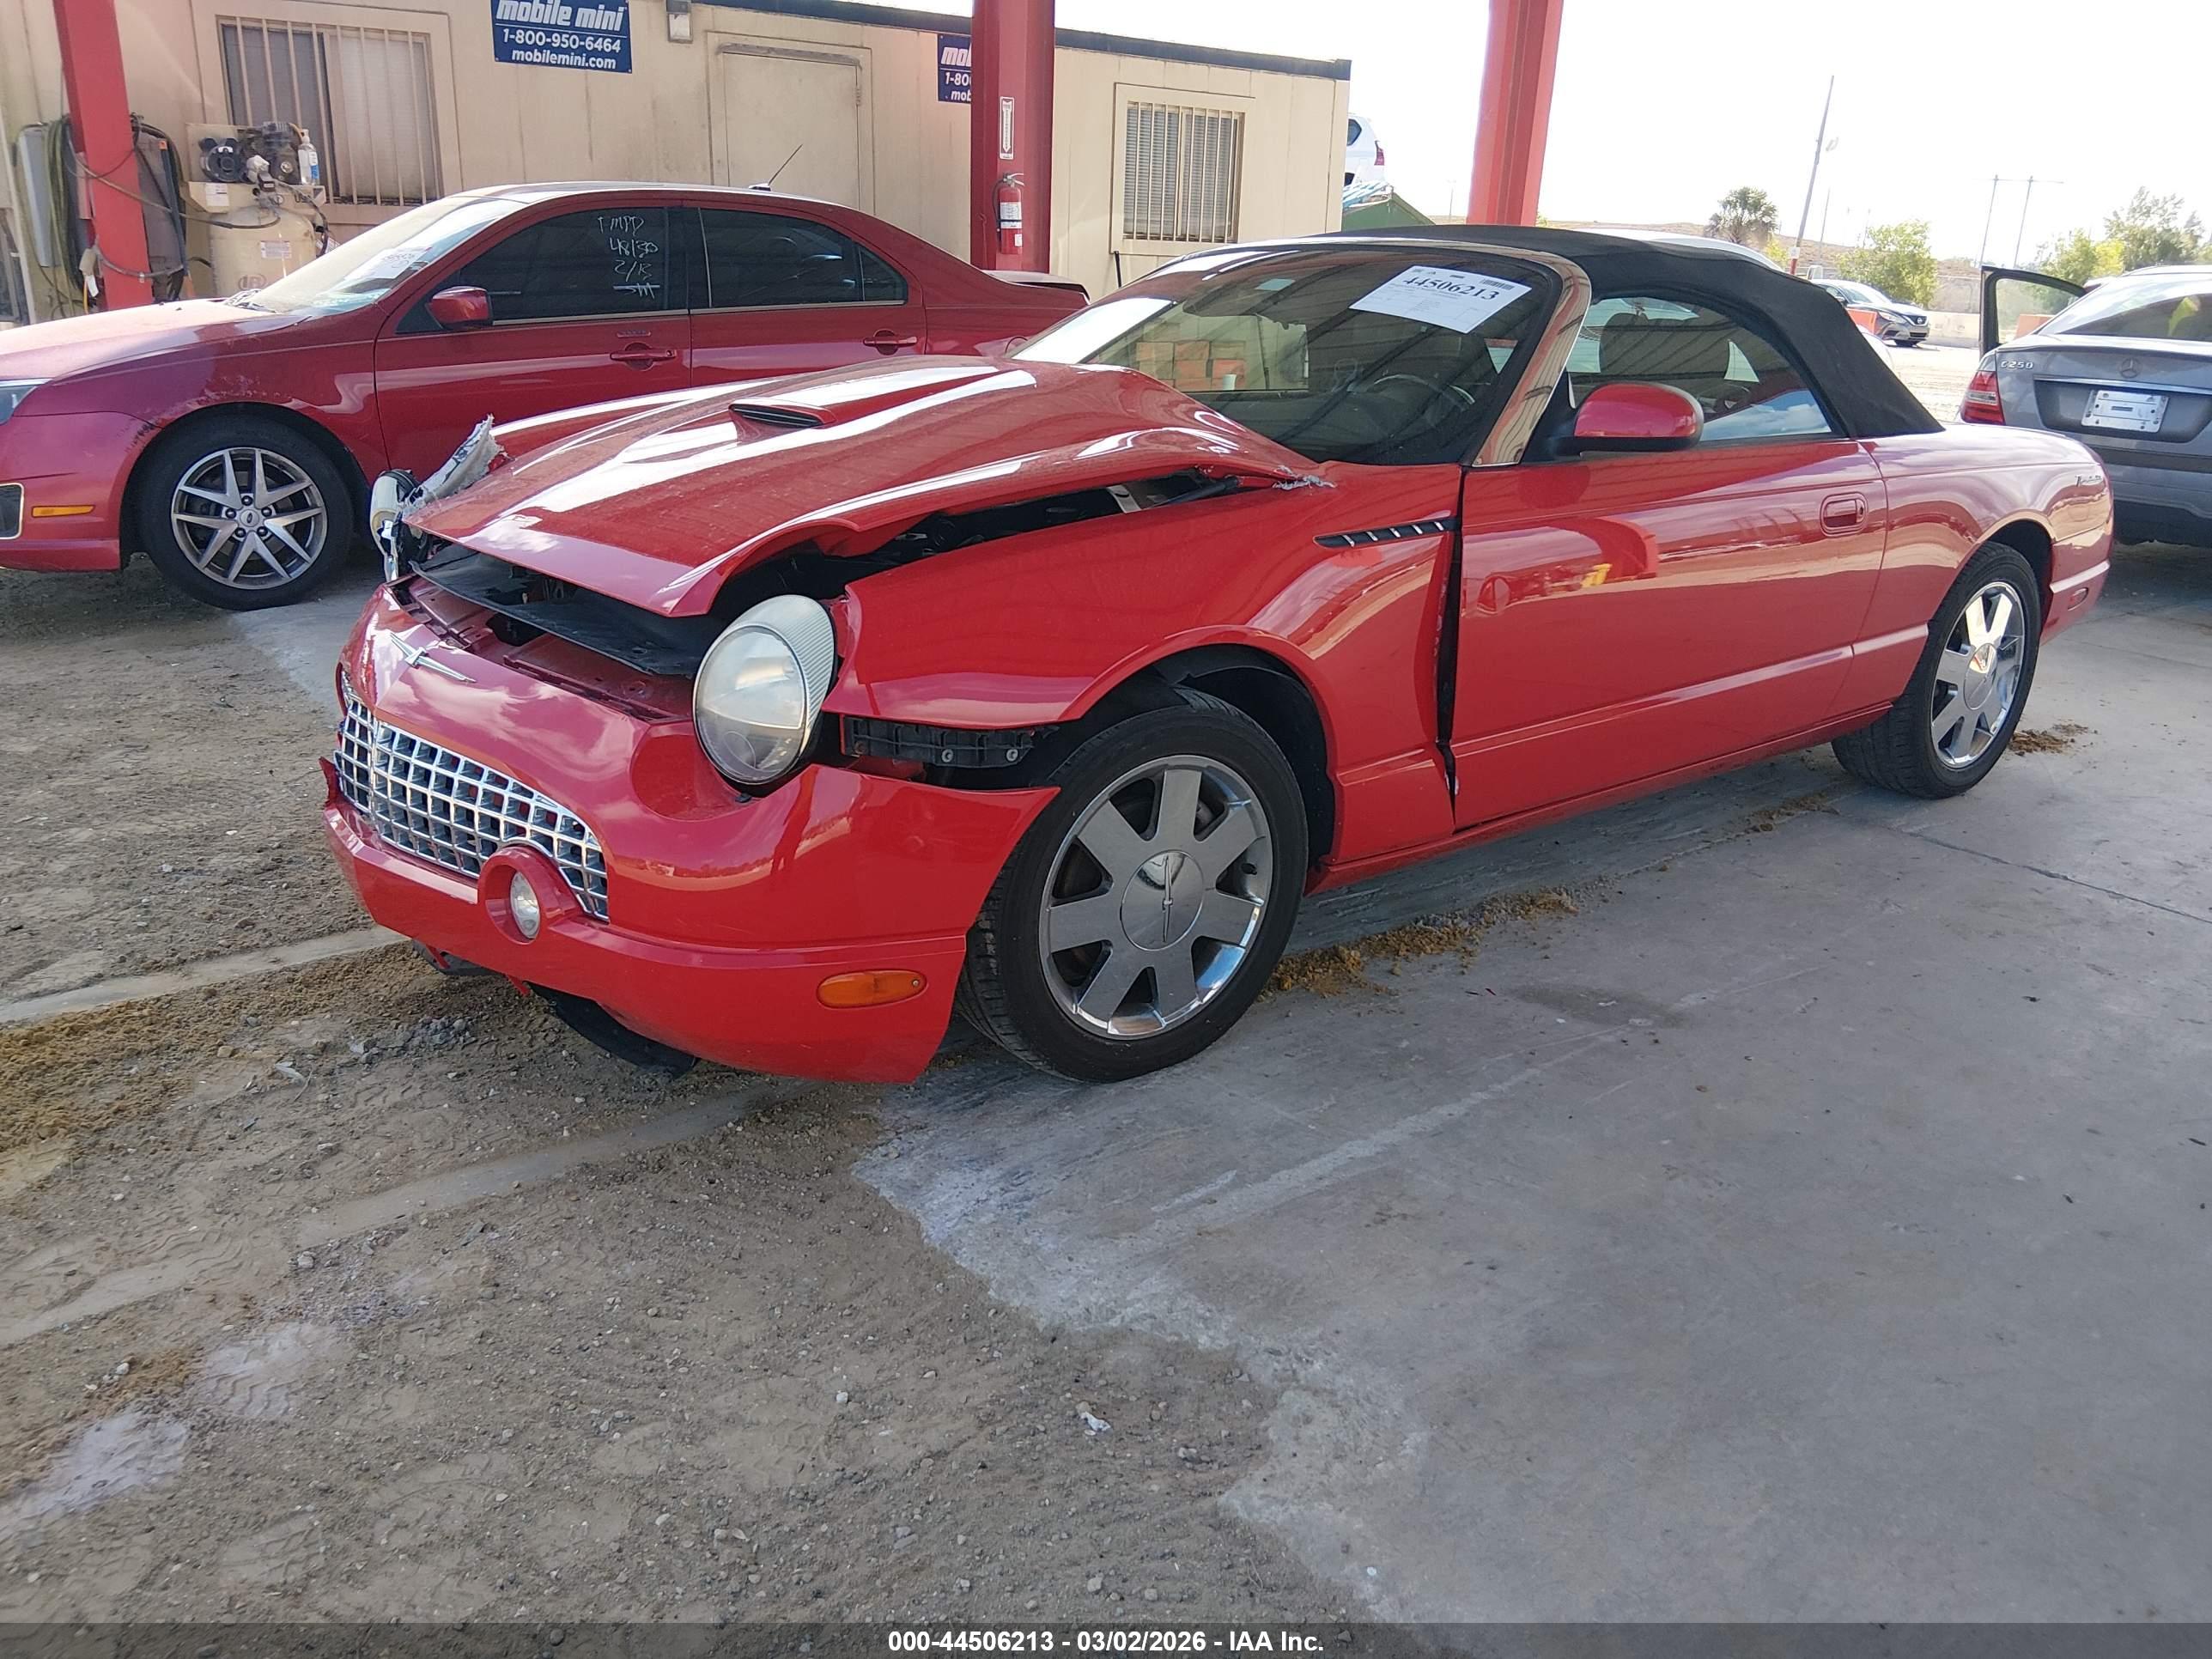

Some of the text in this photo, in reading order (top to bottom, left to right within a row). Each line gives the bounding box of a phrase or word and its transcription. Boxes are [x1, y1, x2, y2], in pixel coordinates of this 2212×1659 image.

[496, 0, 625, 32] mobile mini
[502, 27, 622, 53] 1-800-950-6464
[512, 49, 617, 70] mobilemini.com
[945, 71, 972, 86] 1-80
[1403, 276, 1500, 301] 44506213
